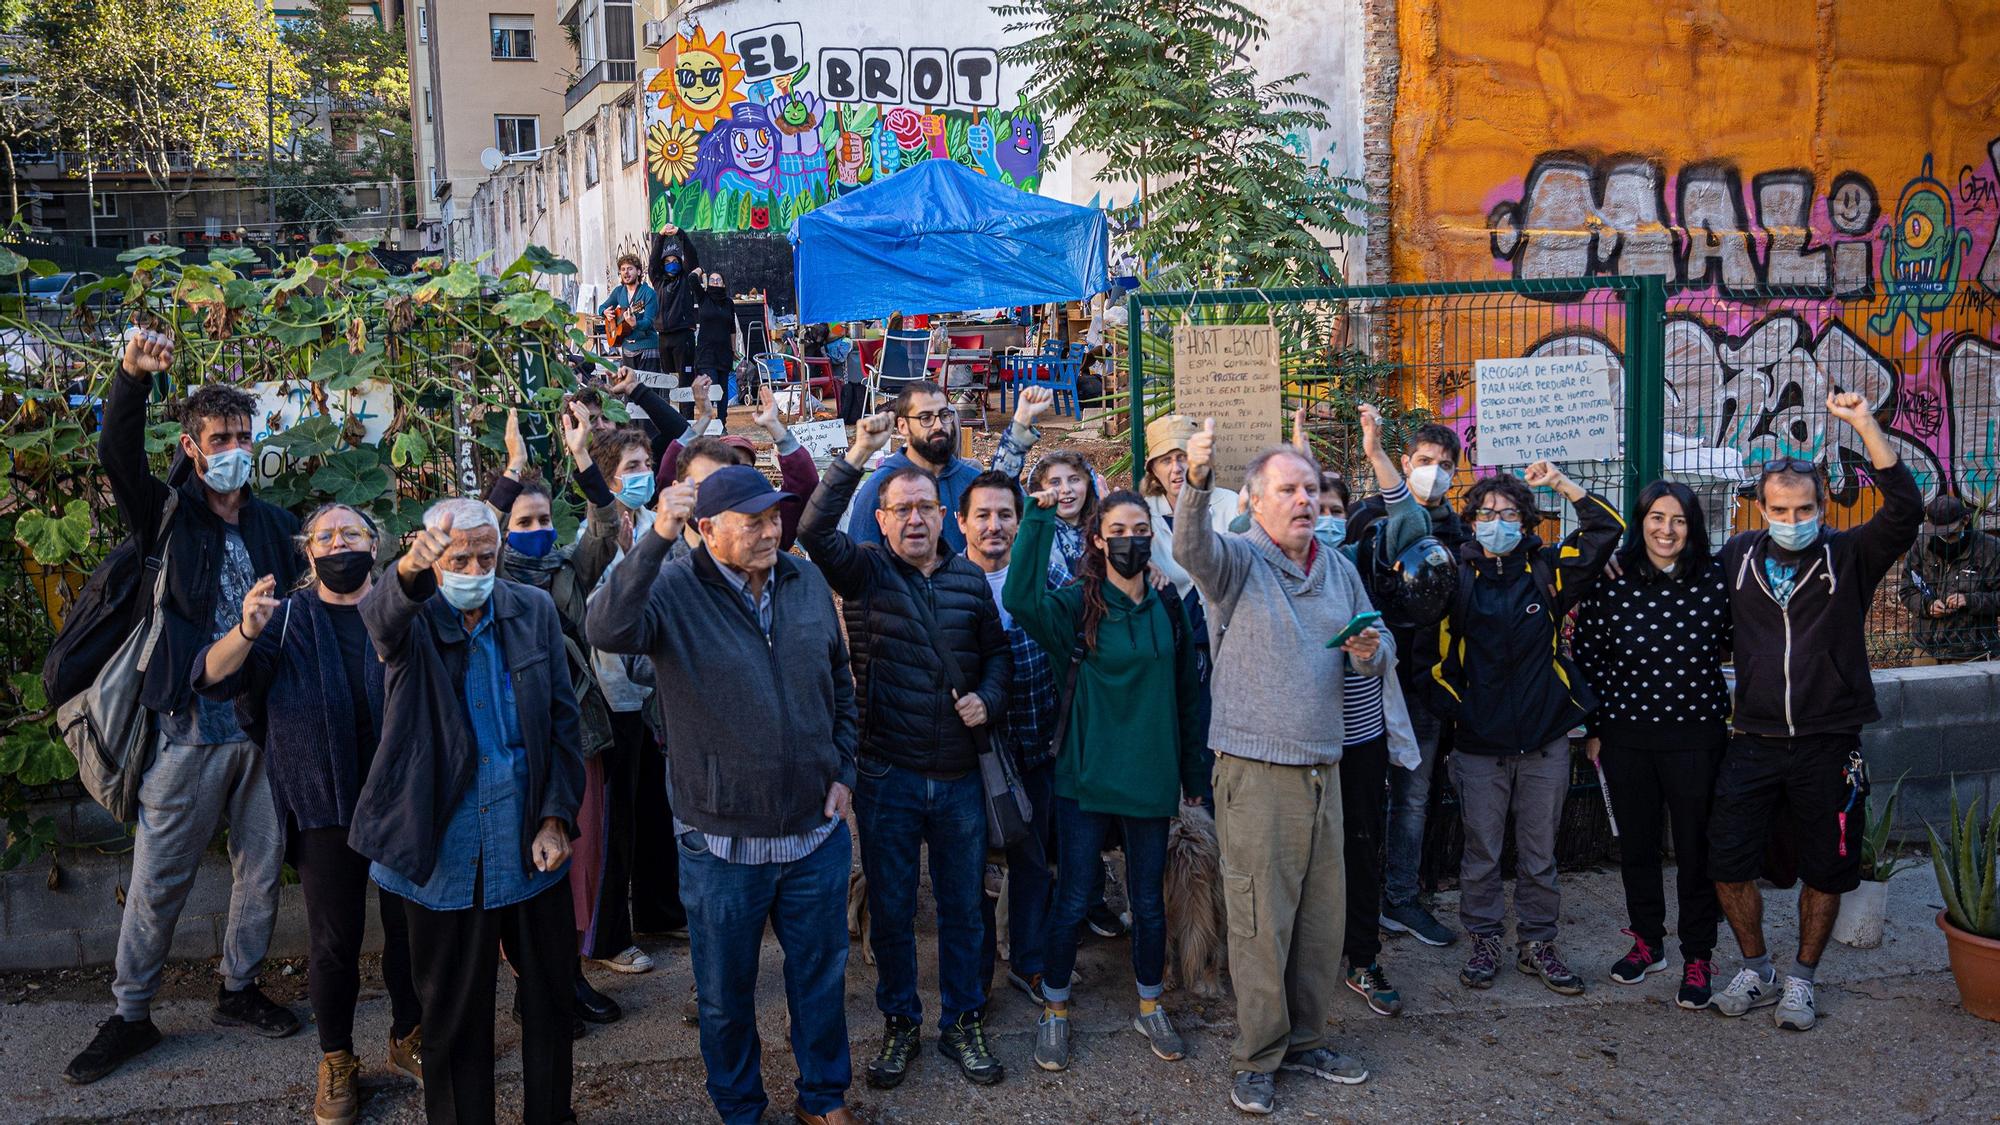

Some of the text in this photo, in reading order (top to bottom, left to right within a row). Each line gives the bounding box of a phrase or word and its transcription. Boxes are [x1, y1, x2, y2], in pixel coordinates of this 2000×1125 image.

[738, 33, 992, 101] EL BROT
[1482, 383, 1505, 394] PARA
[1496, 407, 1518, 419] BROT
[1516, 449, 1531, 459] TU
